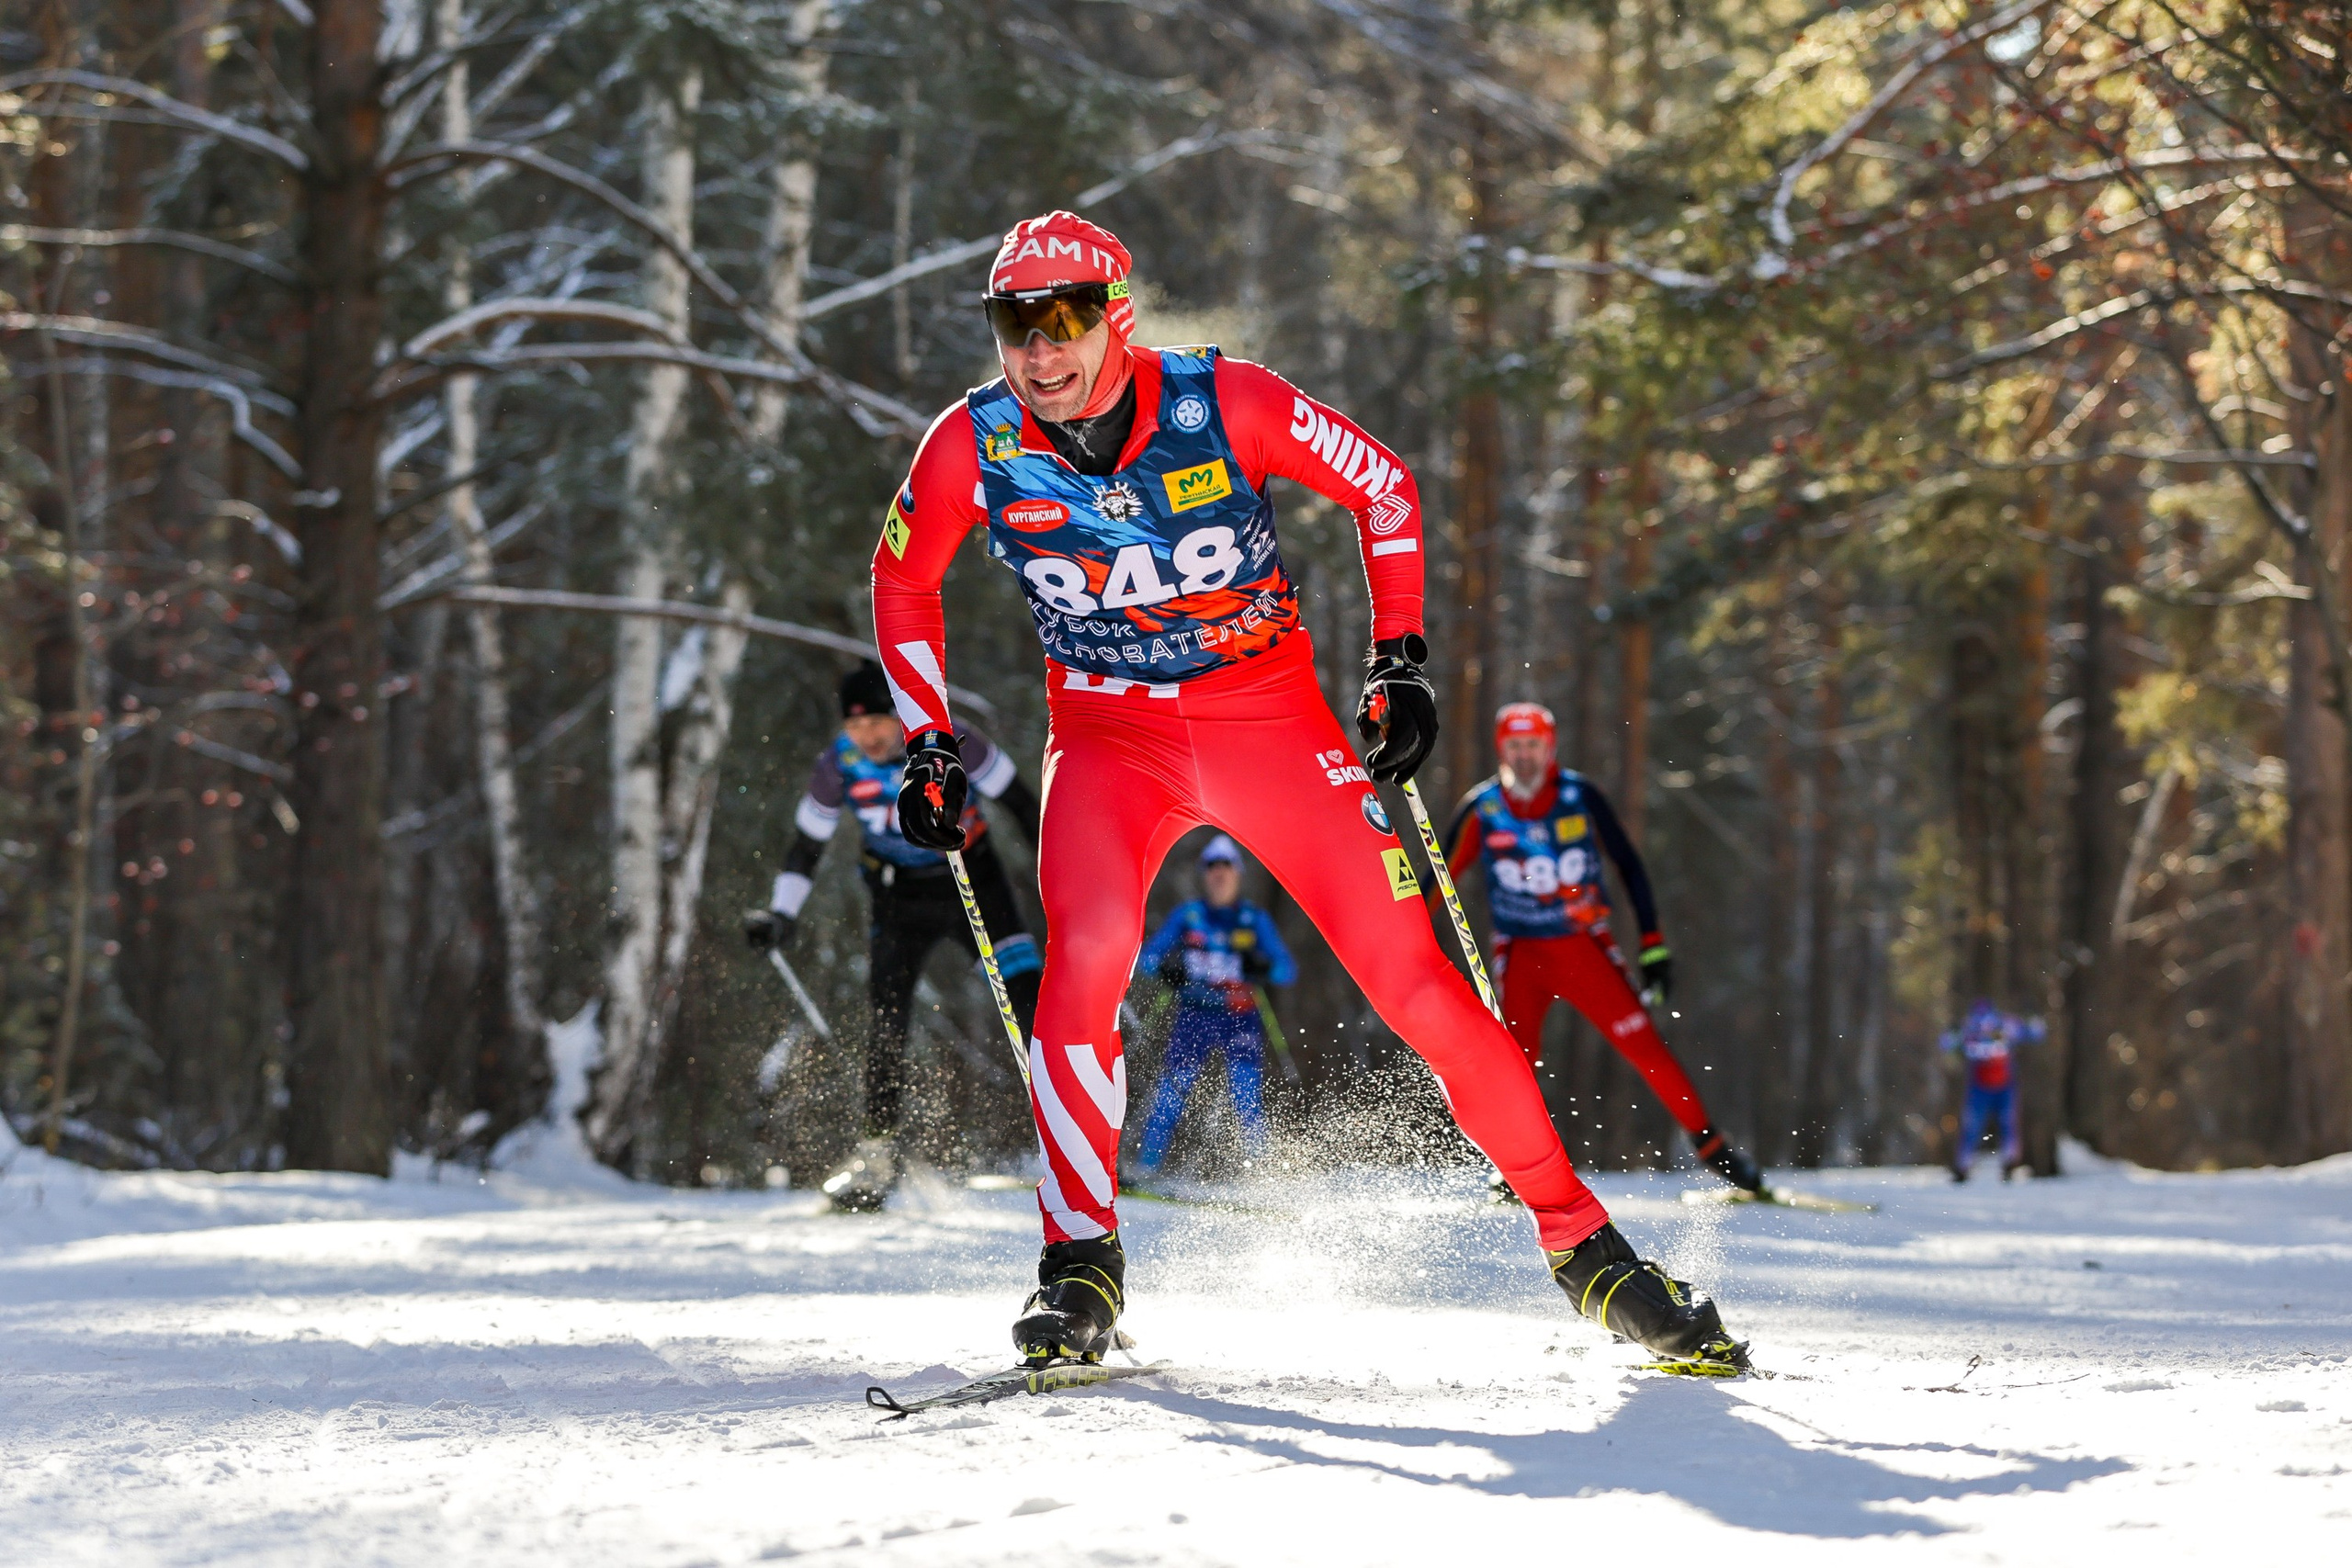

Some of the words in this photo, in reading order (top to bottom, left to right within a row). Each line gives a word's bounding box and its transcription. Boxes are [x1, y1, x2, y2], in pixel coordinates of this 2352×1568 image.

[1007, 506, 1064, 524] КУРГАНСКИЙ
[1023, 525, 1245, 616] 848
[1043, 1366, 1109, 1393] FISCHER
